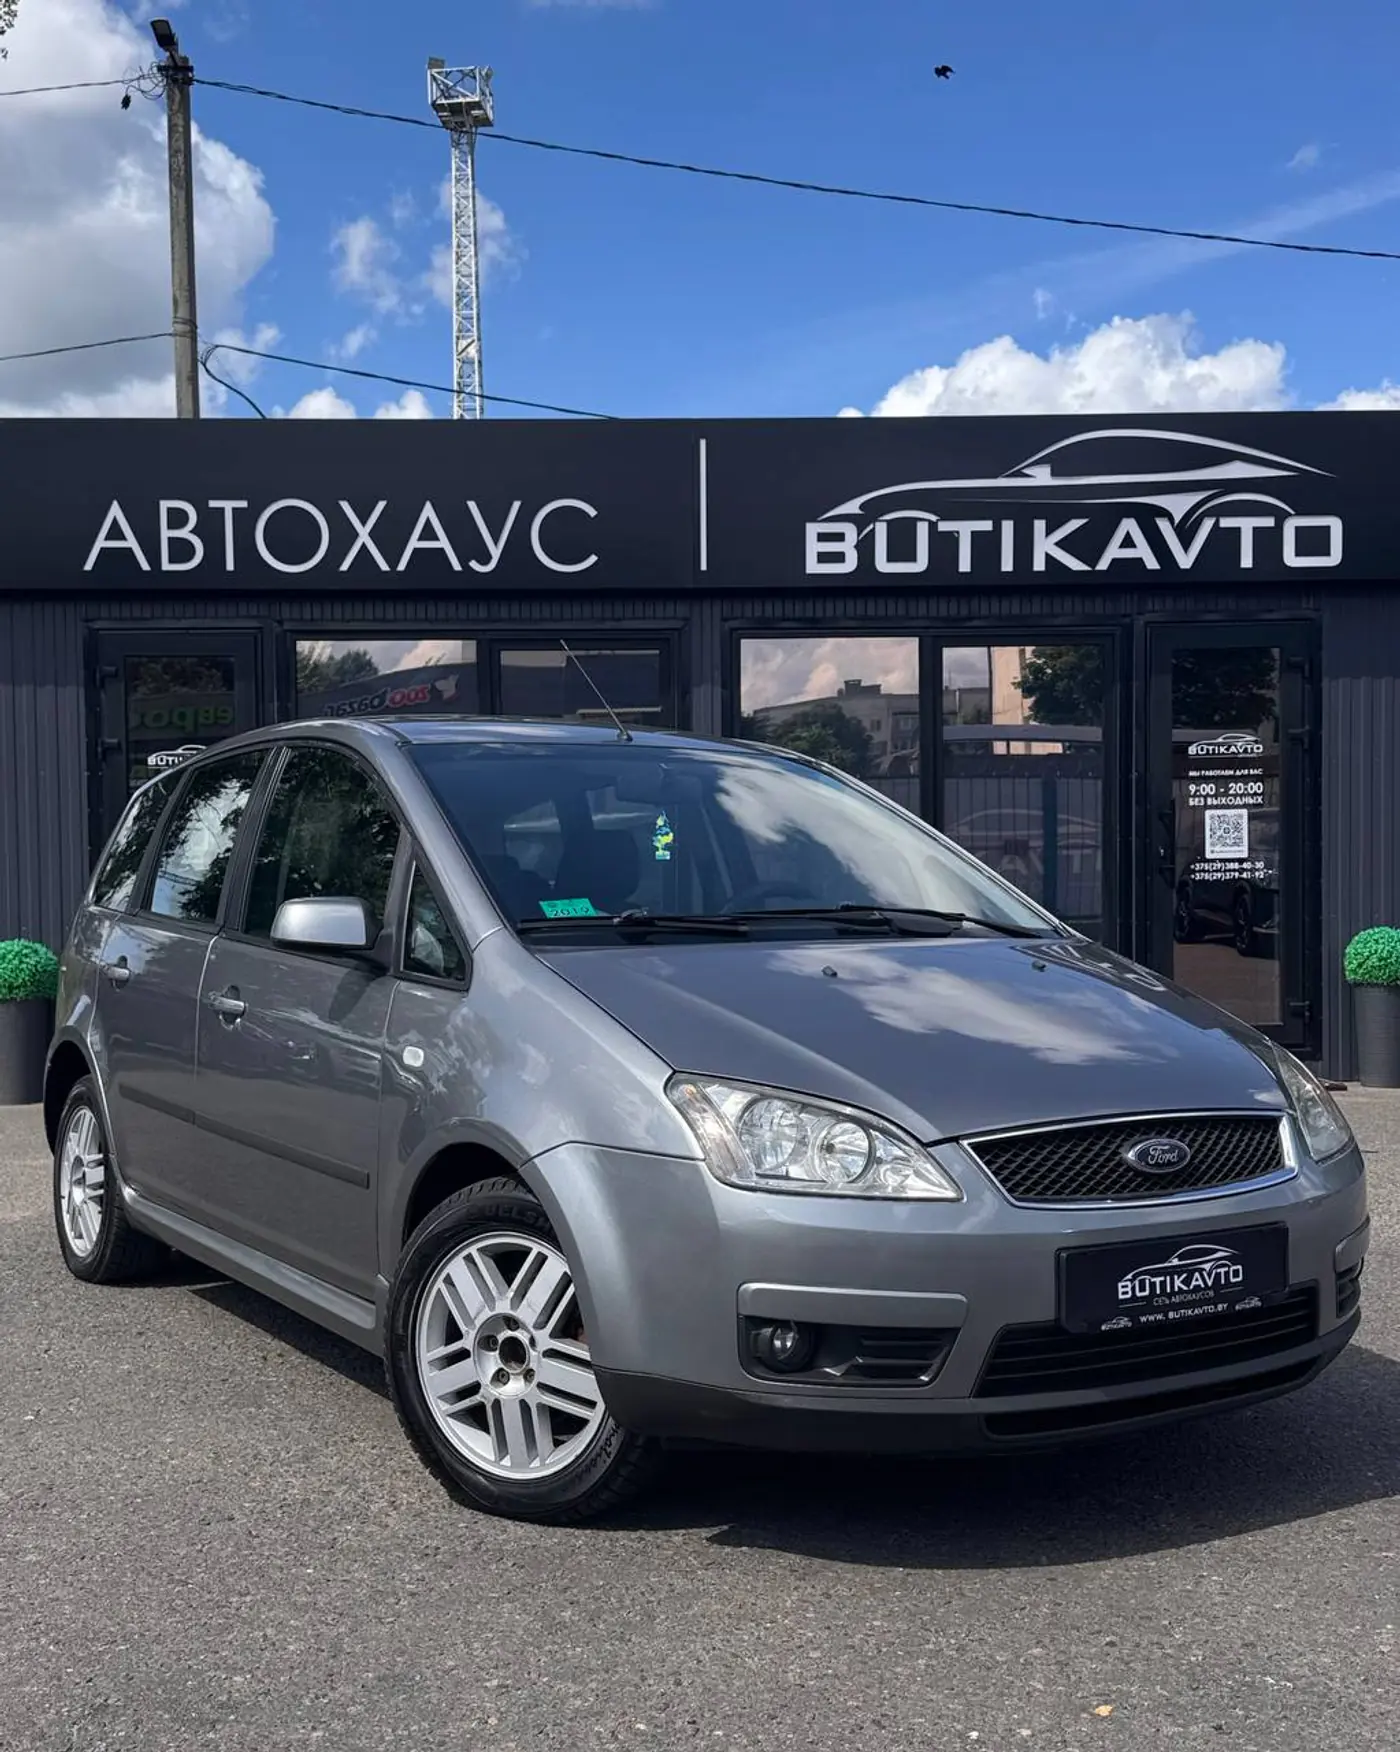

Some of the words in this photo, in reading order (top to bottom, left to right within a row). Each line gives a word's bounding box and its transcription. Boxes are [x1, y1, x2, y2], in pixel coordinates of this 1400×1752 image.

[83, 499, 599, 573] АВТОХАУС
[805, 515, 1343, 574] BUTIKAVTO
[1188, 743, 1264, 755] BUTIKAVTO
[1188, 783, 1216, 796] 9:00
[1228, 782, 1264, 794] 20:00
[1188, 797, 1205, 806] БЕЗ
[1207, 795, 1264, 805] ВЫХОДНЫХ
[1148, 1145, 1179, 1165] Ford
[1118, 1264, 1244, 1300] BUTIKAVTO
[1168, 1303, 1229, 1319] BUTIKAVTO.BY
